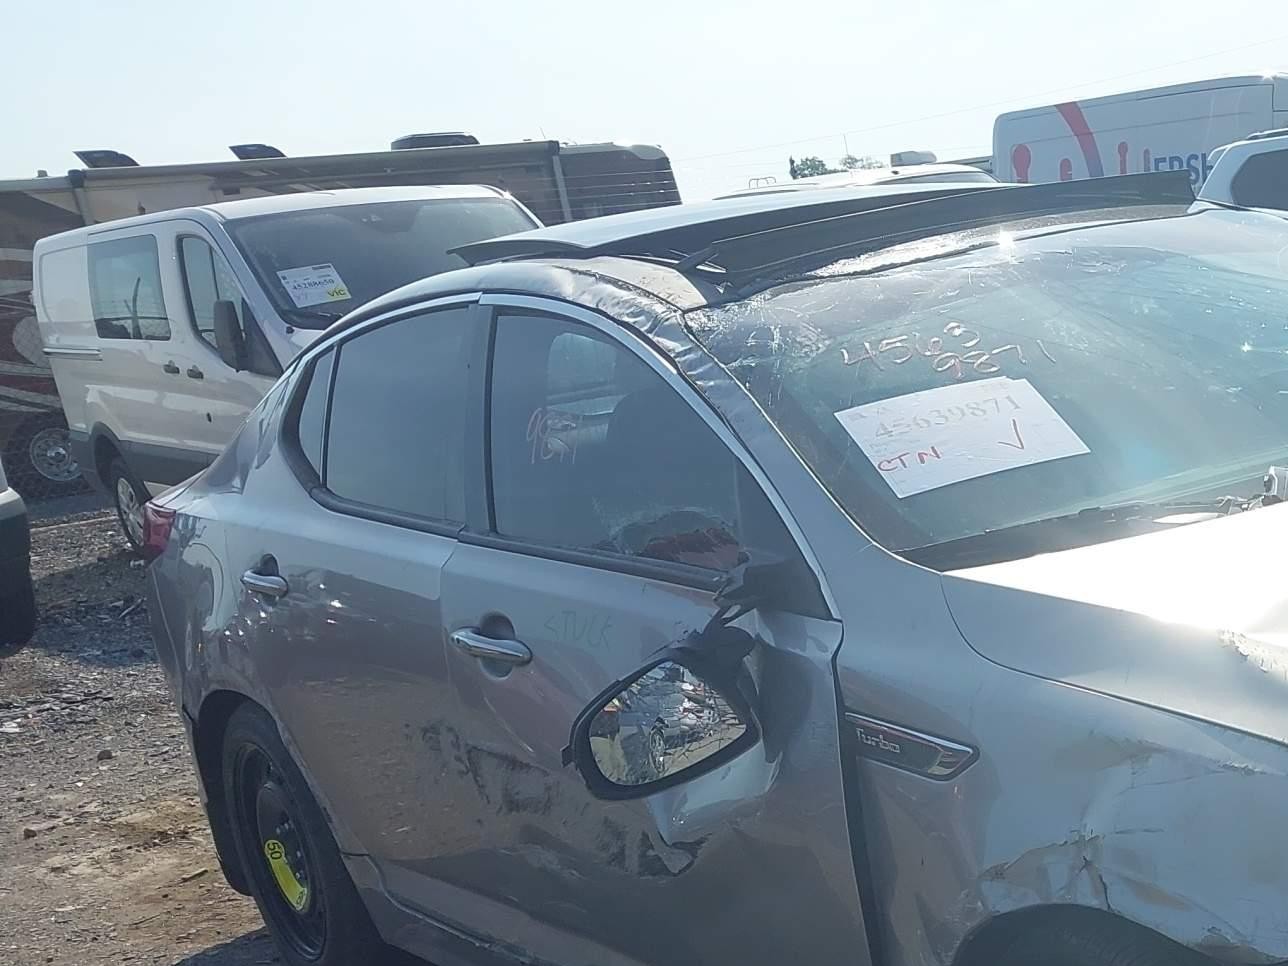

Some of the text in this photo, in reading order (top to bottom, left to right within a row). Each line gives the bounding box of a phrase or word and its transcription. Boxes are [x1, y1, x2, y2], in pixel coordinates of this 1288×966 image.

[874, 394, 1021, 439] 45639871
[856, 727, 900, 753] Turbo
[267, 842, 283, 860] 50
